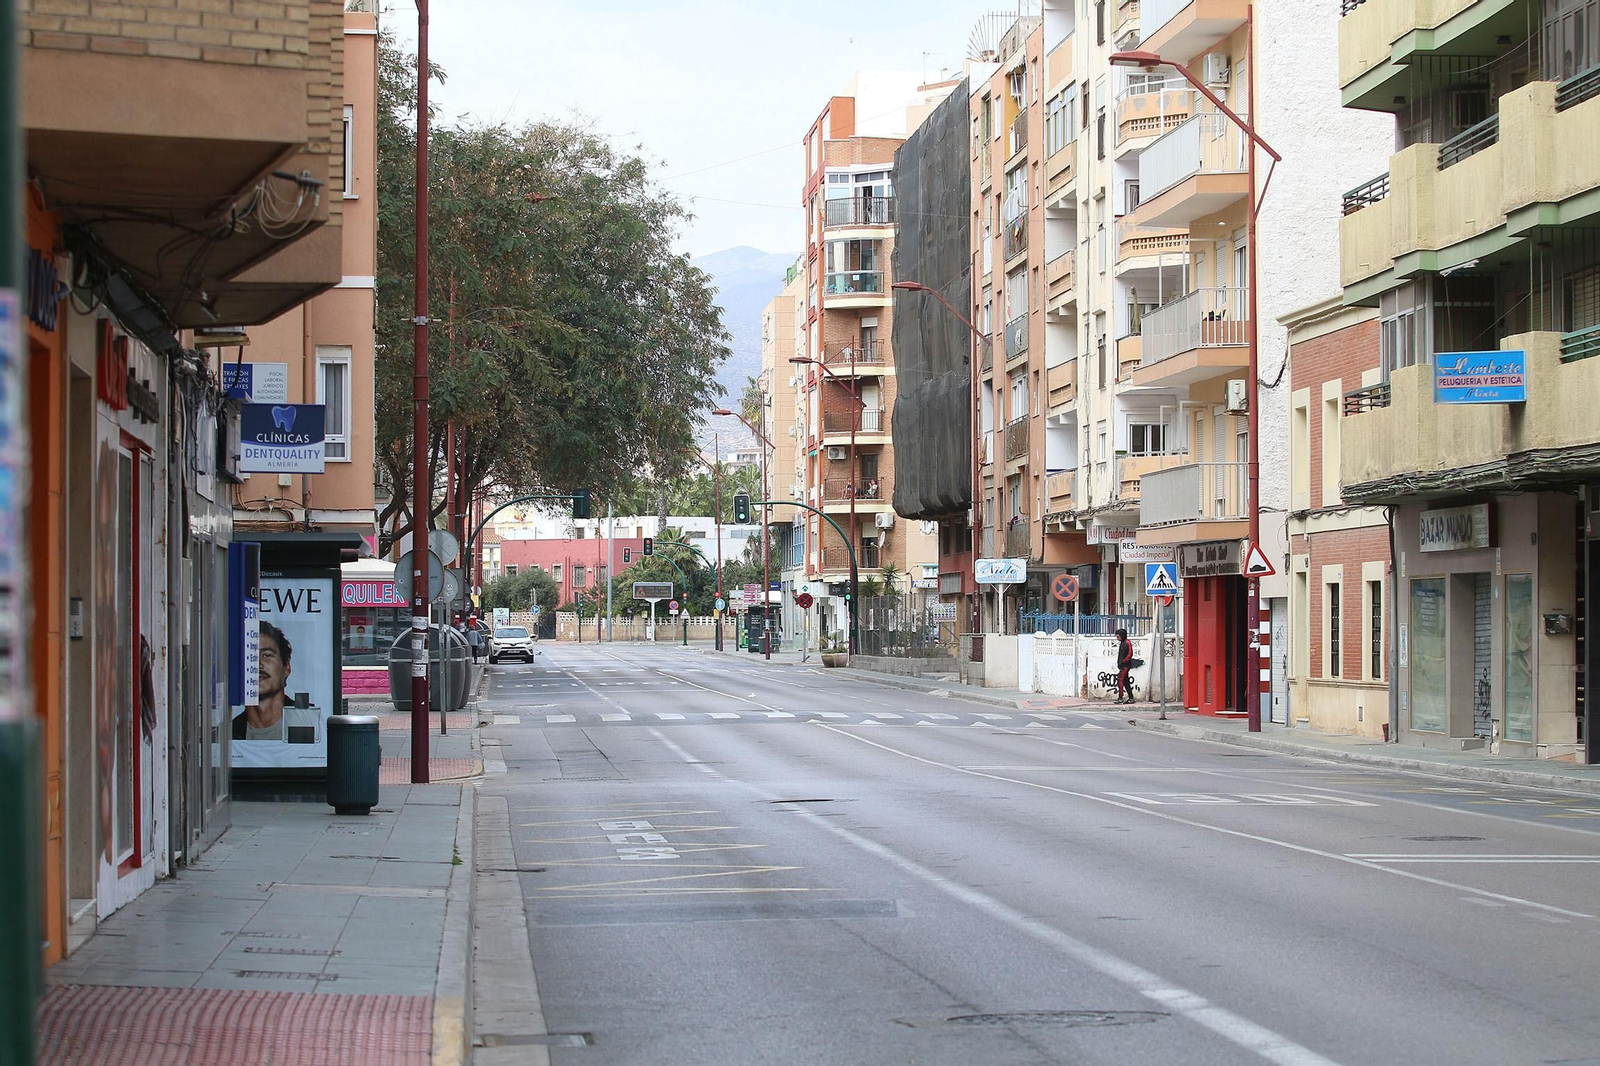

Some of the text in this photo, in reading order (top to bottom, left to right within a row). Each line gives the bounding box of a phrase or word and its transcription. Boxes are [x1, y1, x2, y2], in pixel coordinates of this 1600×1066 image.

[1438, 377, 1482, 386] PELUQUERIA
[1482, 377, 1488, 385] Y
[256, 431, 310, 443] CLÍNICAS
[245, 448, 321, 460] DENTQUALITY
[1104, 527, 1125, 539] Ciudad
[1420, 515, 1445, 546] BAZAR
[1446, 513, 1473, 544] MUNDO
